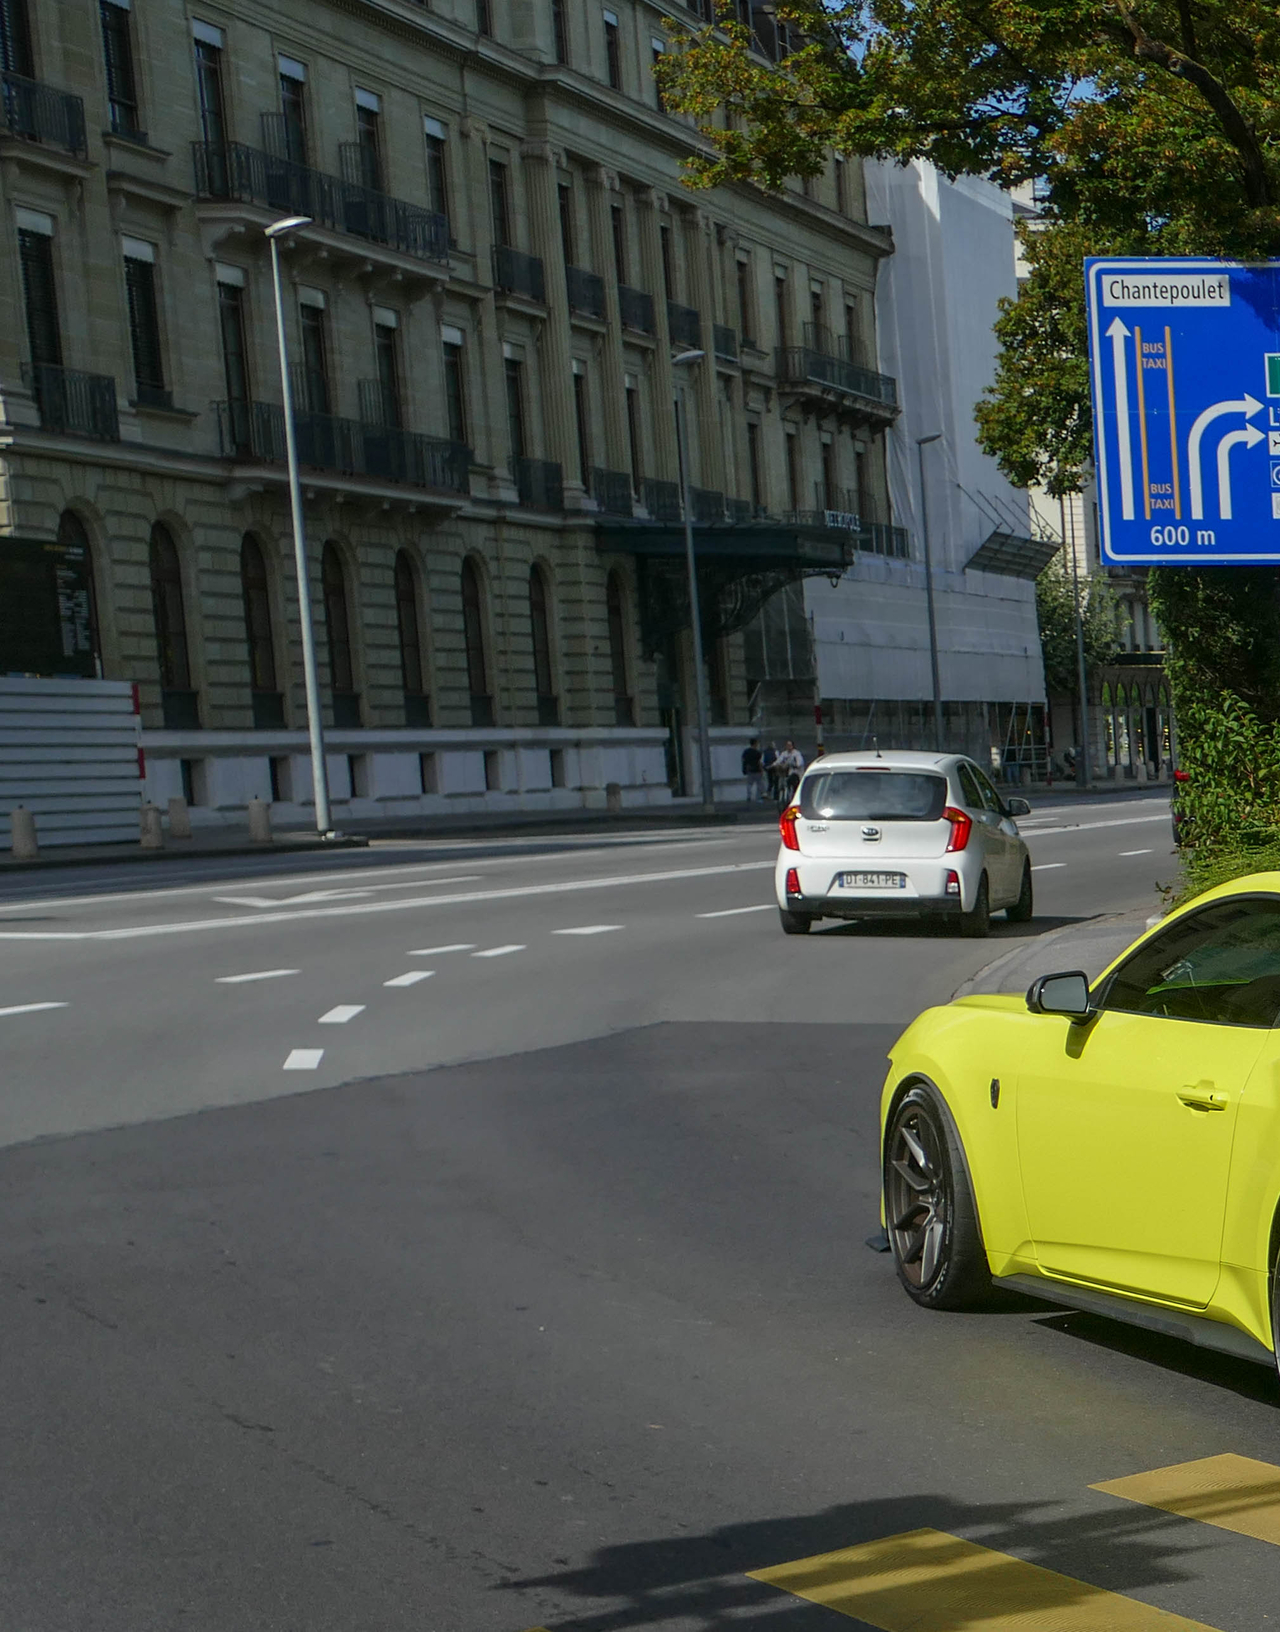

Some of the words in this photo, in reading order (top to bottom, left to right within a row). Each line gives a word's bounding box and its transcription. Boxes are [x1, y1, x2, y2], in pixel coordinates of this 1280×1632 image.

[1109, 278, 1225, 305] Chantepoulet
[1142, 342, 1164, 354] BUS
[1142, 357, 1167, 369] TAXI
[1150, 483, 1172, 494] BUS
[1150, 498, 1175, 510] TAXI
[1150, 525, 1190, 546] 600
[1197, 530, 1216, 546] m
[845, 873, 898, 886] DT-841-PE
